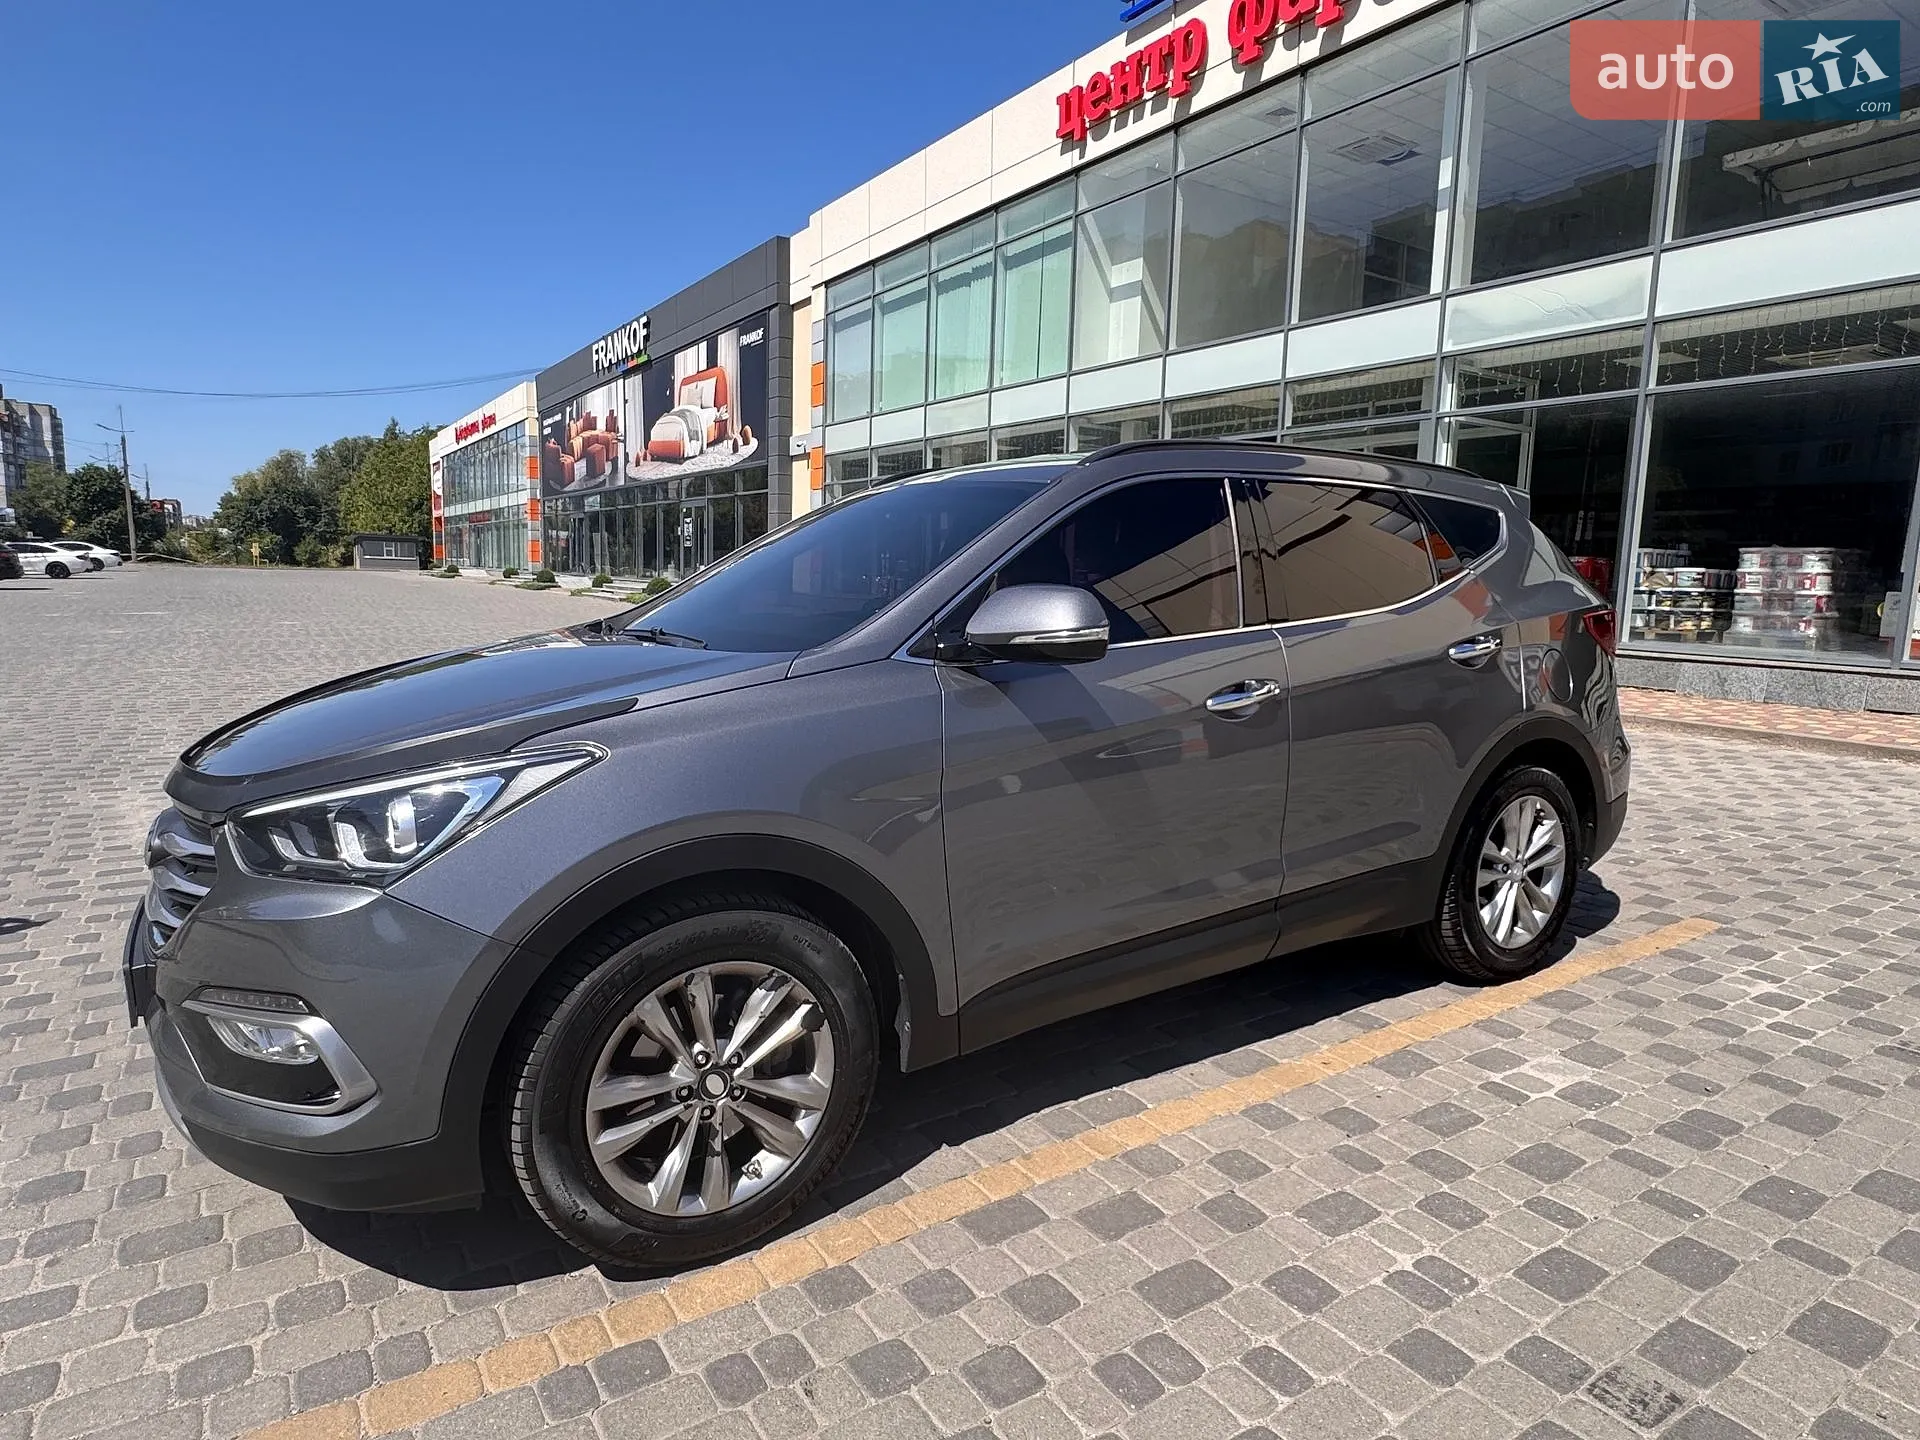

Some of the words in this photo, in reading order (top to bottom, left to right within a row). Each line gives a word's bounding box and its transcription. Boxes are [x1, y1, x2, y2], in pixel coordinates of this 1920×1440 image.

[1056, 18, 1208, 141] центр
[592, 315, 648, 374] FRANKOF
[739, 327, 764, 348] FRANKOF
